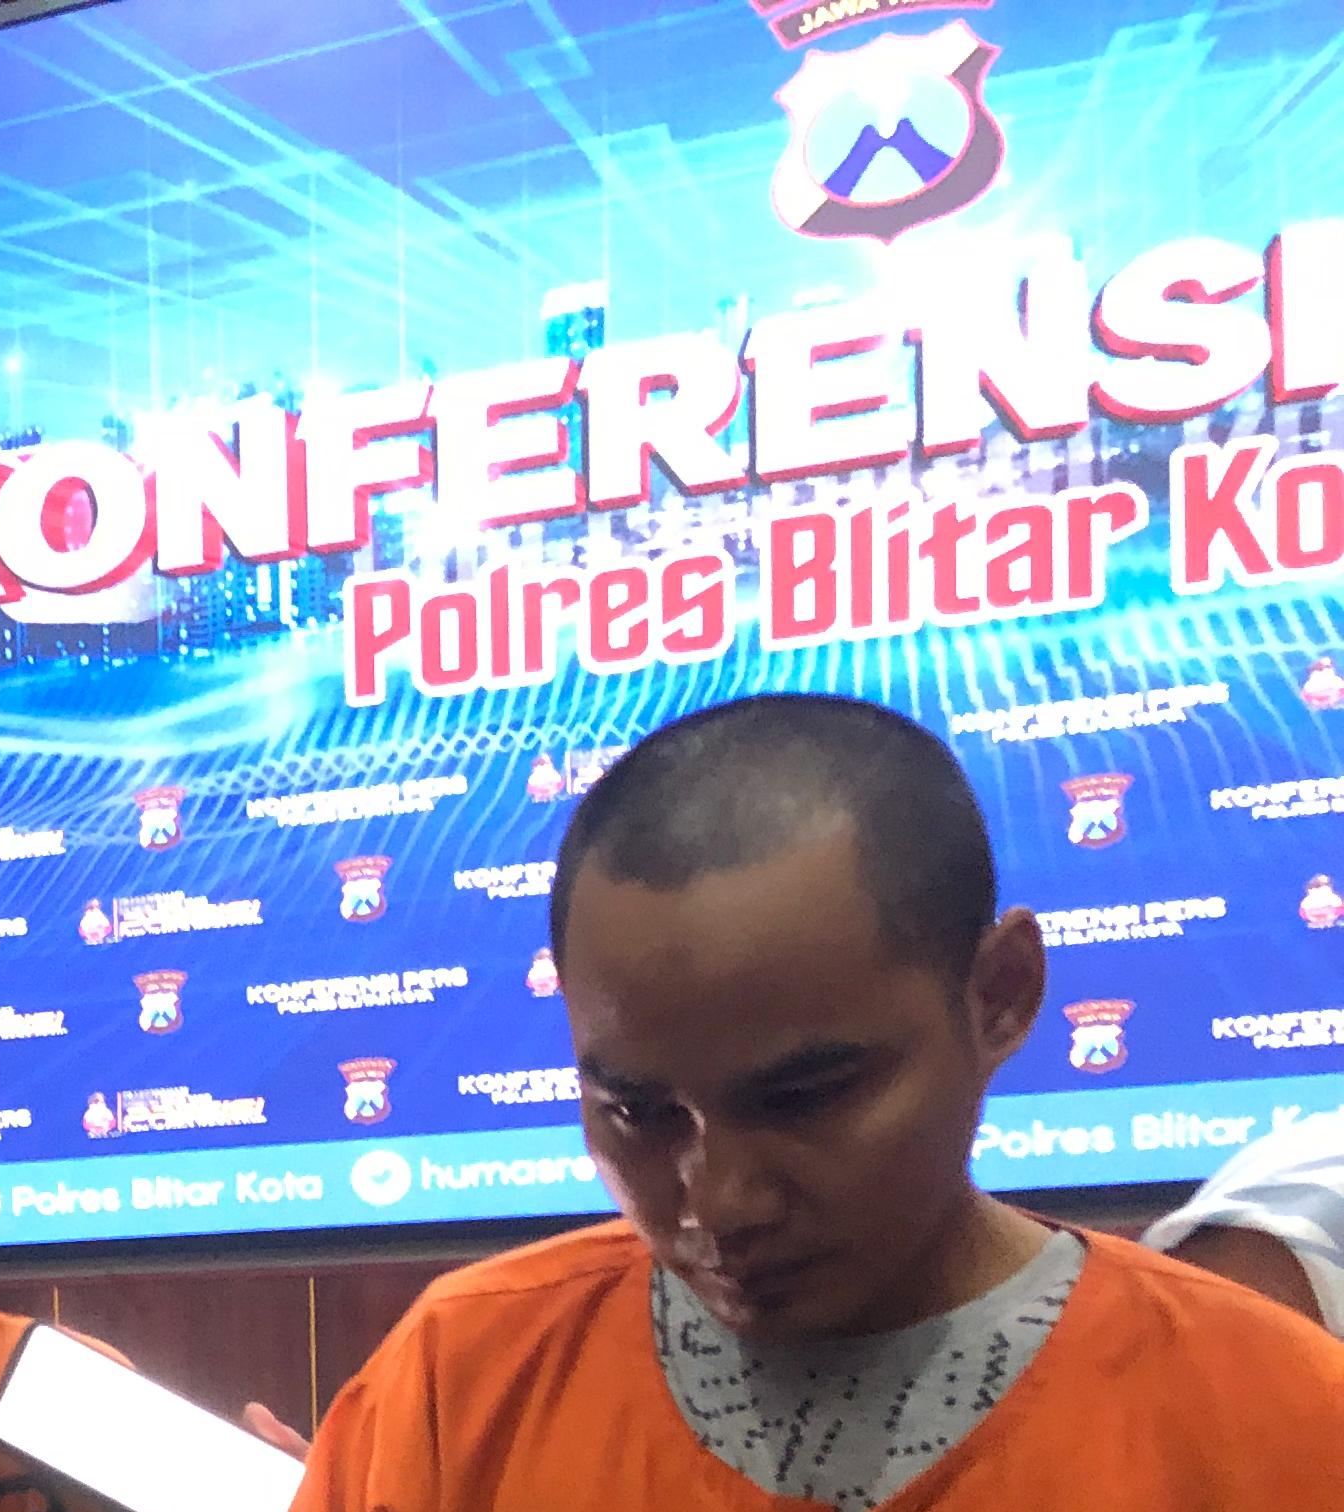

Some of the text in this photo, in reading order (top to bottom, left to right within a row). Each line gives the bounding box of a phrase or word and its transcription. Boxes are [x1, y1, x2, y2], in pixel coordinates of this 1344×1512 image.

[352, 552, 726, 699] Polres
[769, 489, 1140, 641] Blitar
[972, 1118, 1116, 1160] Polres
[1129, 1109, 1257, 1151] Blitar
[11, 1169, 324, 1217] Polres Blitar Kota
